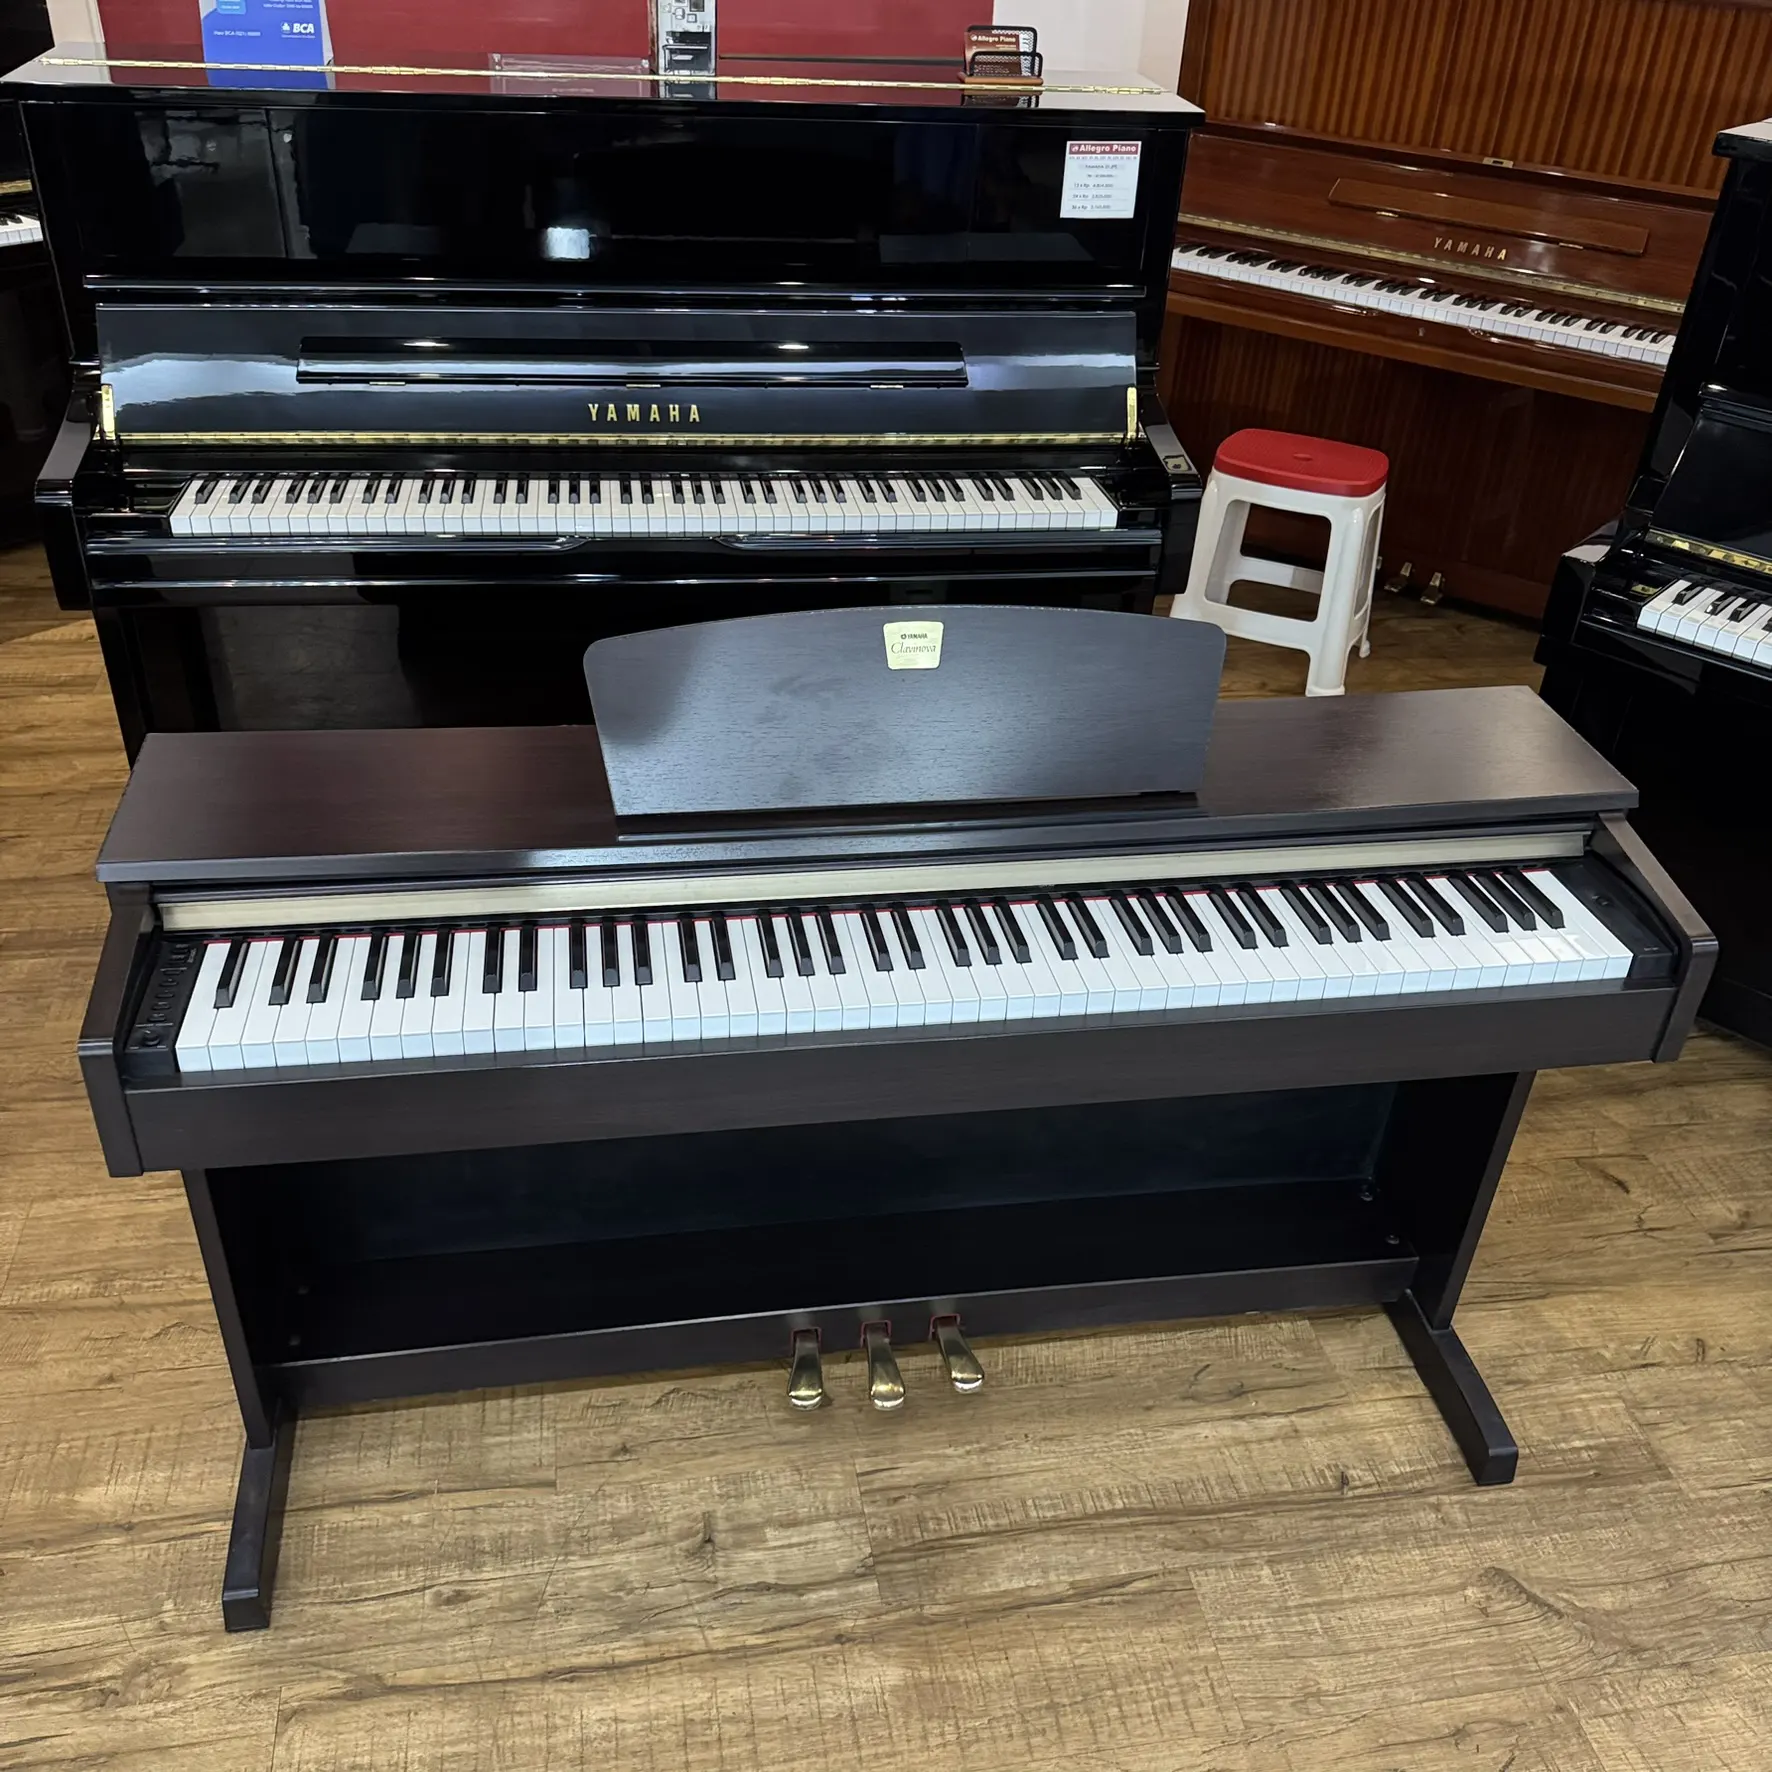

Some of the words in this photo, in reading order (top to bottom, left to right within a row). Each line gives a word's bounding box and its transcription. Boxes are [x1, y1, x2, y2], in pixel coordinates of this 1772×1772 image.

[292, 22, 315, 34] BCA
[977, 35, 999, 43] Allegro
[1079, 144, 1110, 153] Allegro
[1112, 144, 1137, 152] Piano
[1433, 236, 1507, 261] YAMAHA
[587, 403, 700, 423] YAMAHA
[890, 641, 937, 655] Clavinova
